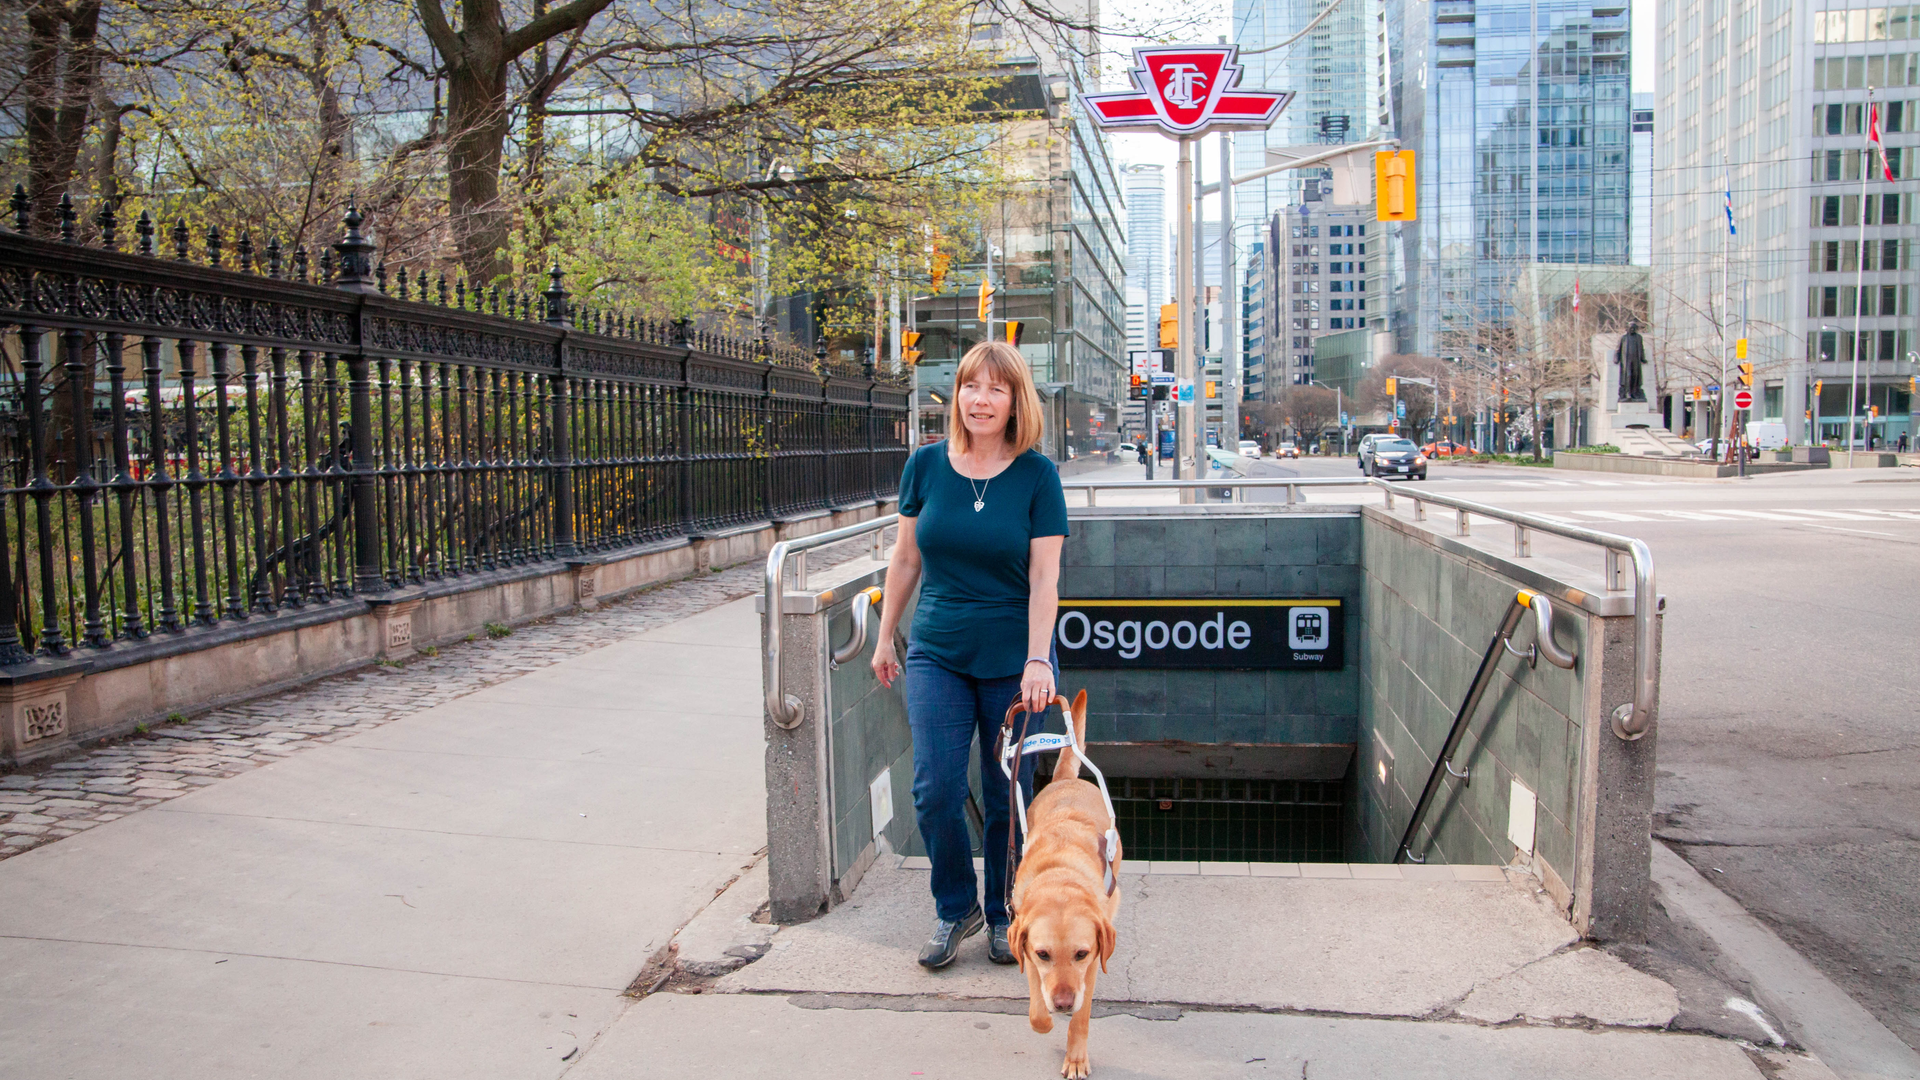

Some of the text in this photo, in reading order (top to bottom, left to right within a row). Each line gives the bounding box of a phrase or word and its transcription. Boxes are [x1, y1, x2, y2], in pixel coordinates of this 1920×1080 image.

[1159, 63, 1208, 109] TTC
[1058, 610, 1251, 659] Osgoode
[1293, 652, 1324, 662] Subway
